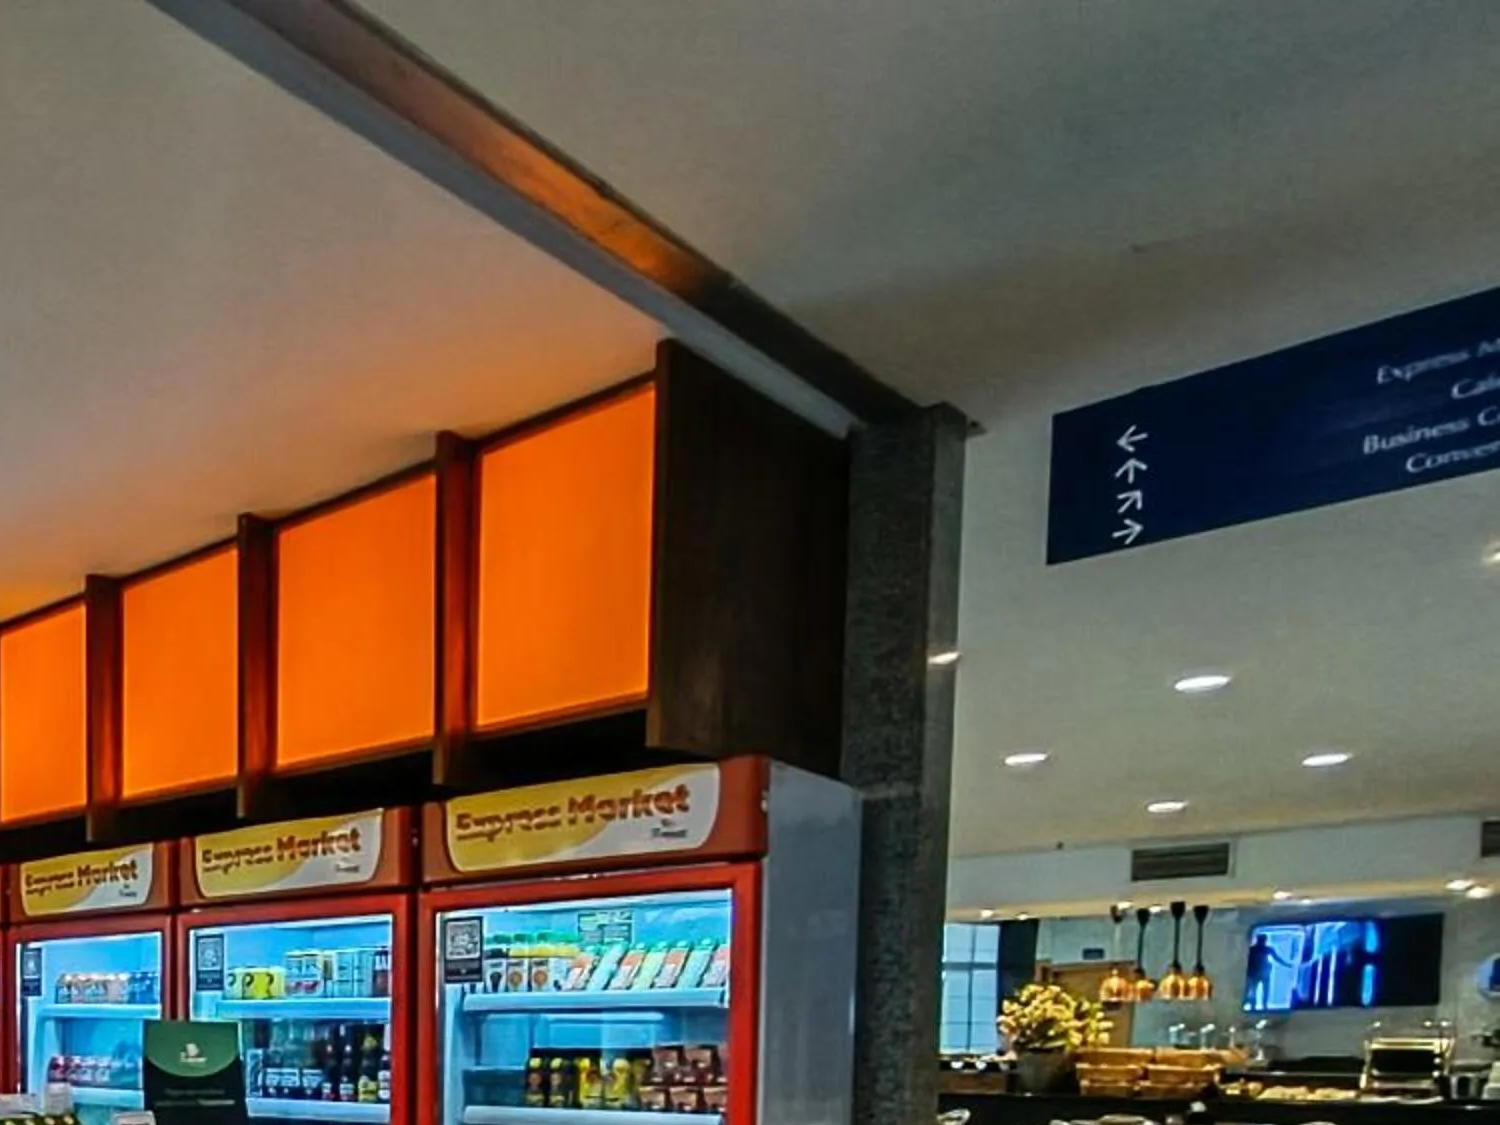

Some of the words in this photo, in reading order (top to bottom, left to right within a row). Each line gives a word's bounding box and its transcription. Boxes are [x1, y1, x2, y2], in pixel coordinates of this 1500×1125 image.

[1376, 350, 1471, 384] Express
[1363, 417, 1470, 455] Business
[456, 804, 561, 842] Express
[567, 783, 690, 828] Market
[276, 827, 361, 862] Market
